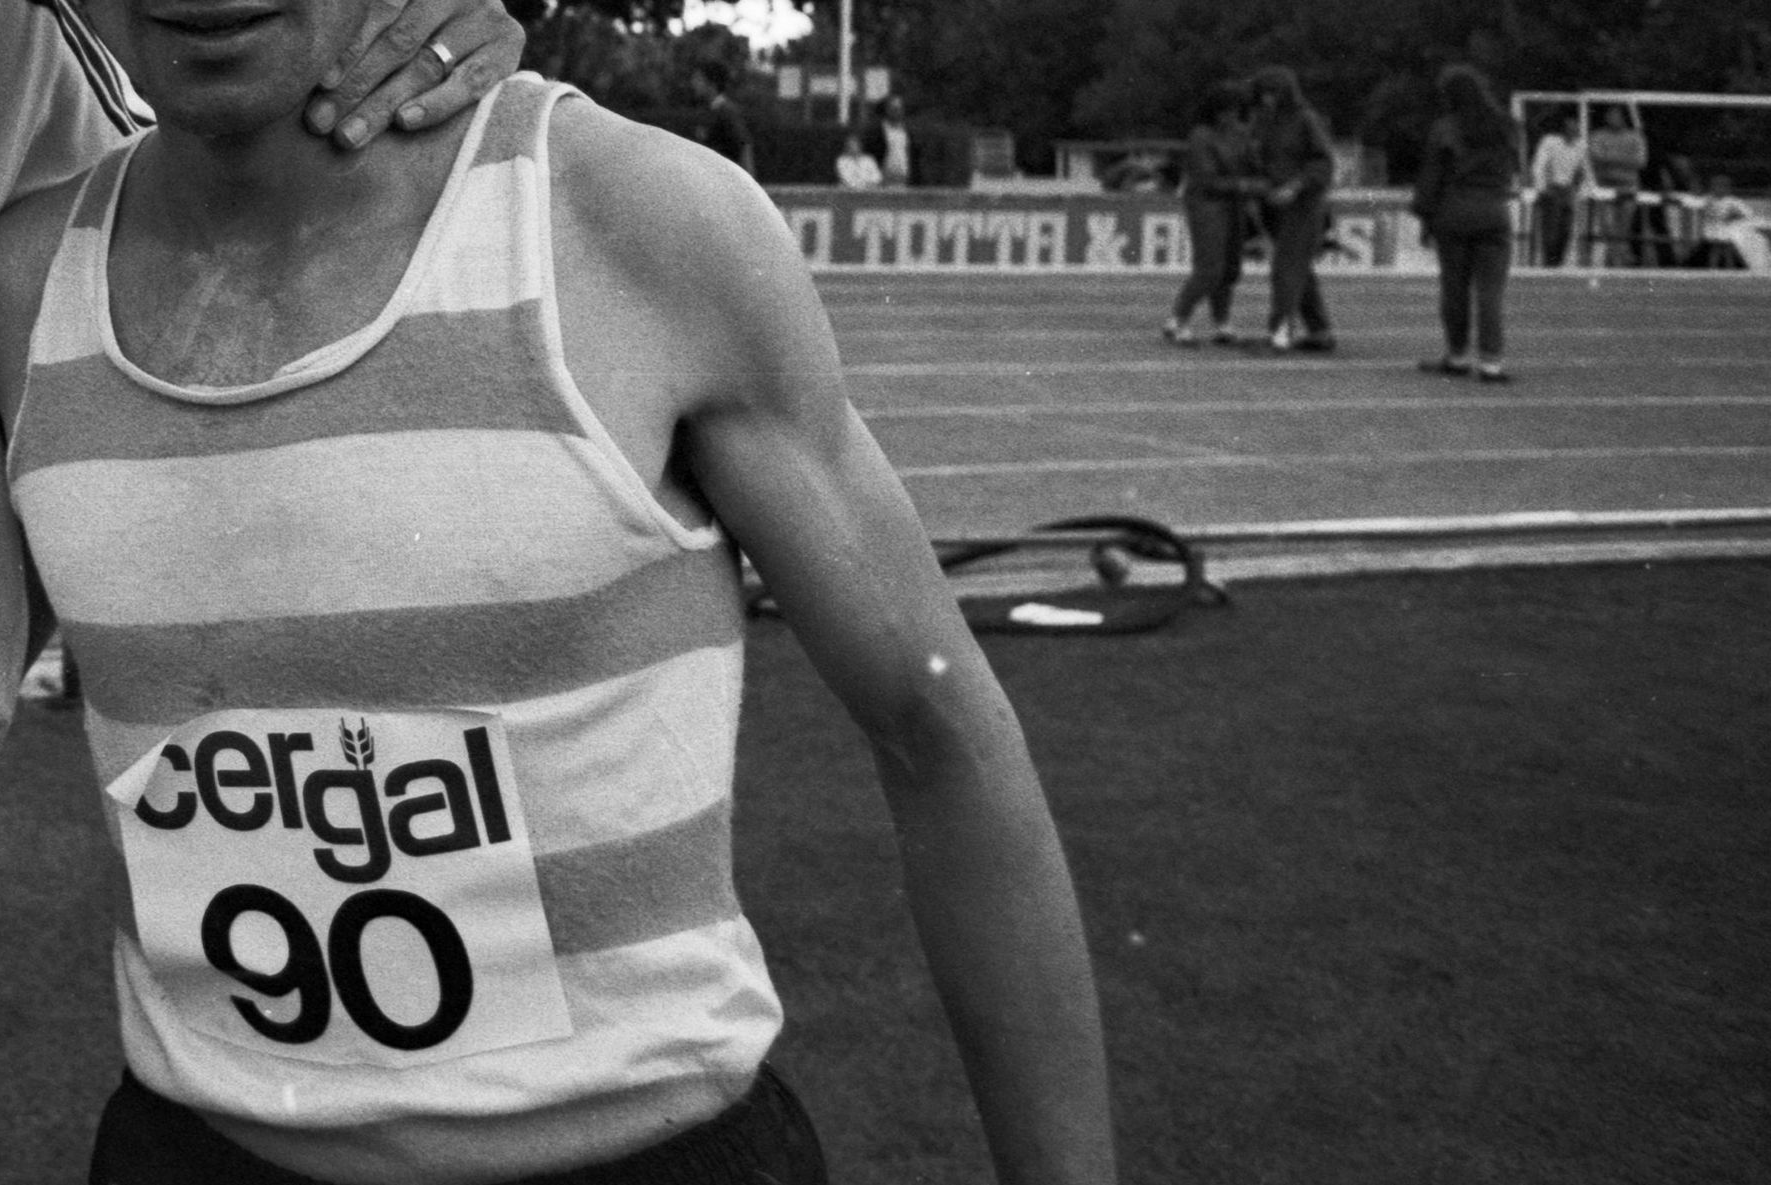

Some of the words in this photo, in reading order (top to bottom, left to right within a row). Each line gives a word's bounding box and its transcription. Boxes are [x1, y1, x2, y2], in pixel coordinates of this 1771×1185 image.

[852, 209, 1067, 265] TOTTA
[1084, 211, 1127, 265] &
[134, 725, 512, 884] cergal
[201, 883, 474, 1052] 90
